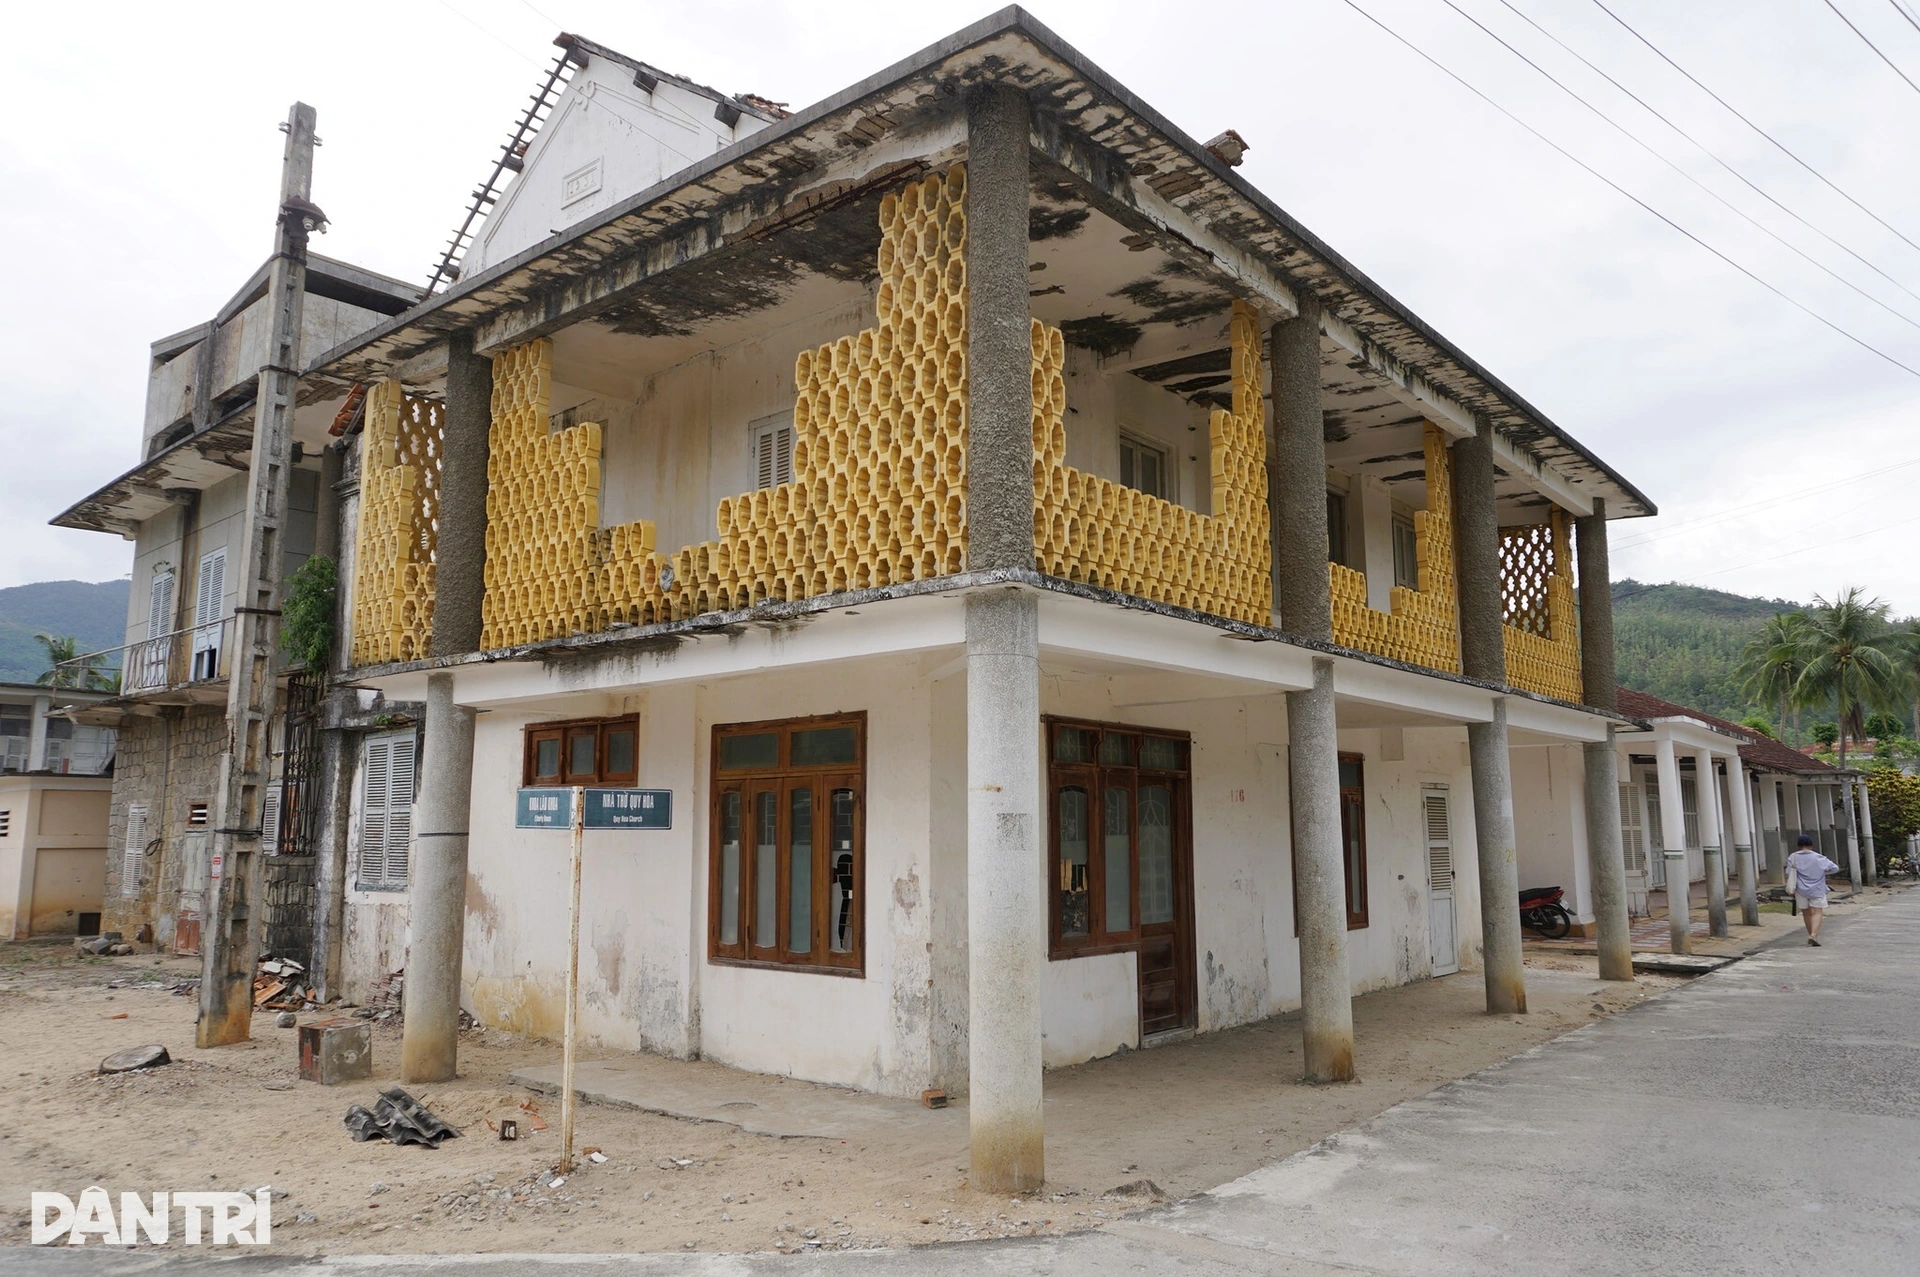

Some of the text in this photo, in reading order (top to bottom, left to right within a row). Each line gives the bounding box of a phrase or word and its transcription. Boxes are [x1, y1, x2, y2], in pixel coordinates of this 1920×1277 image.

[603, 791, 615, 808] NHÀ
[617, 790, 629, 809] THỜ
[629, 794, 642, 811] QUY
[613, 815, 643, 824] Quy Hoa Church
